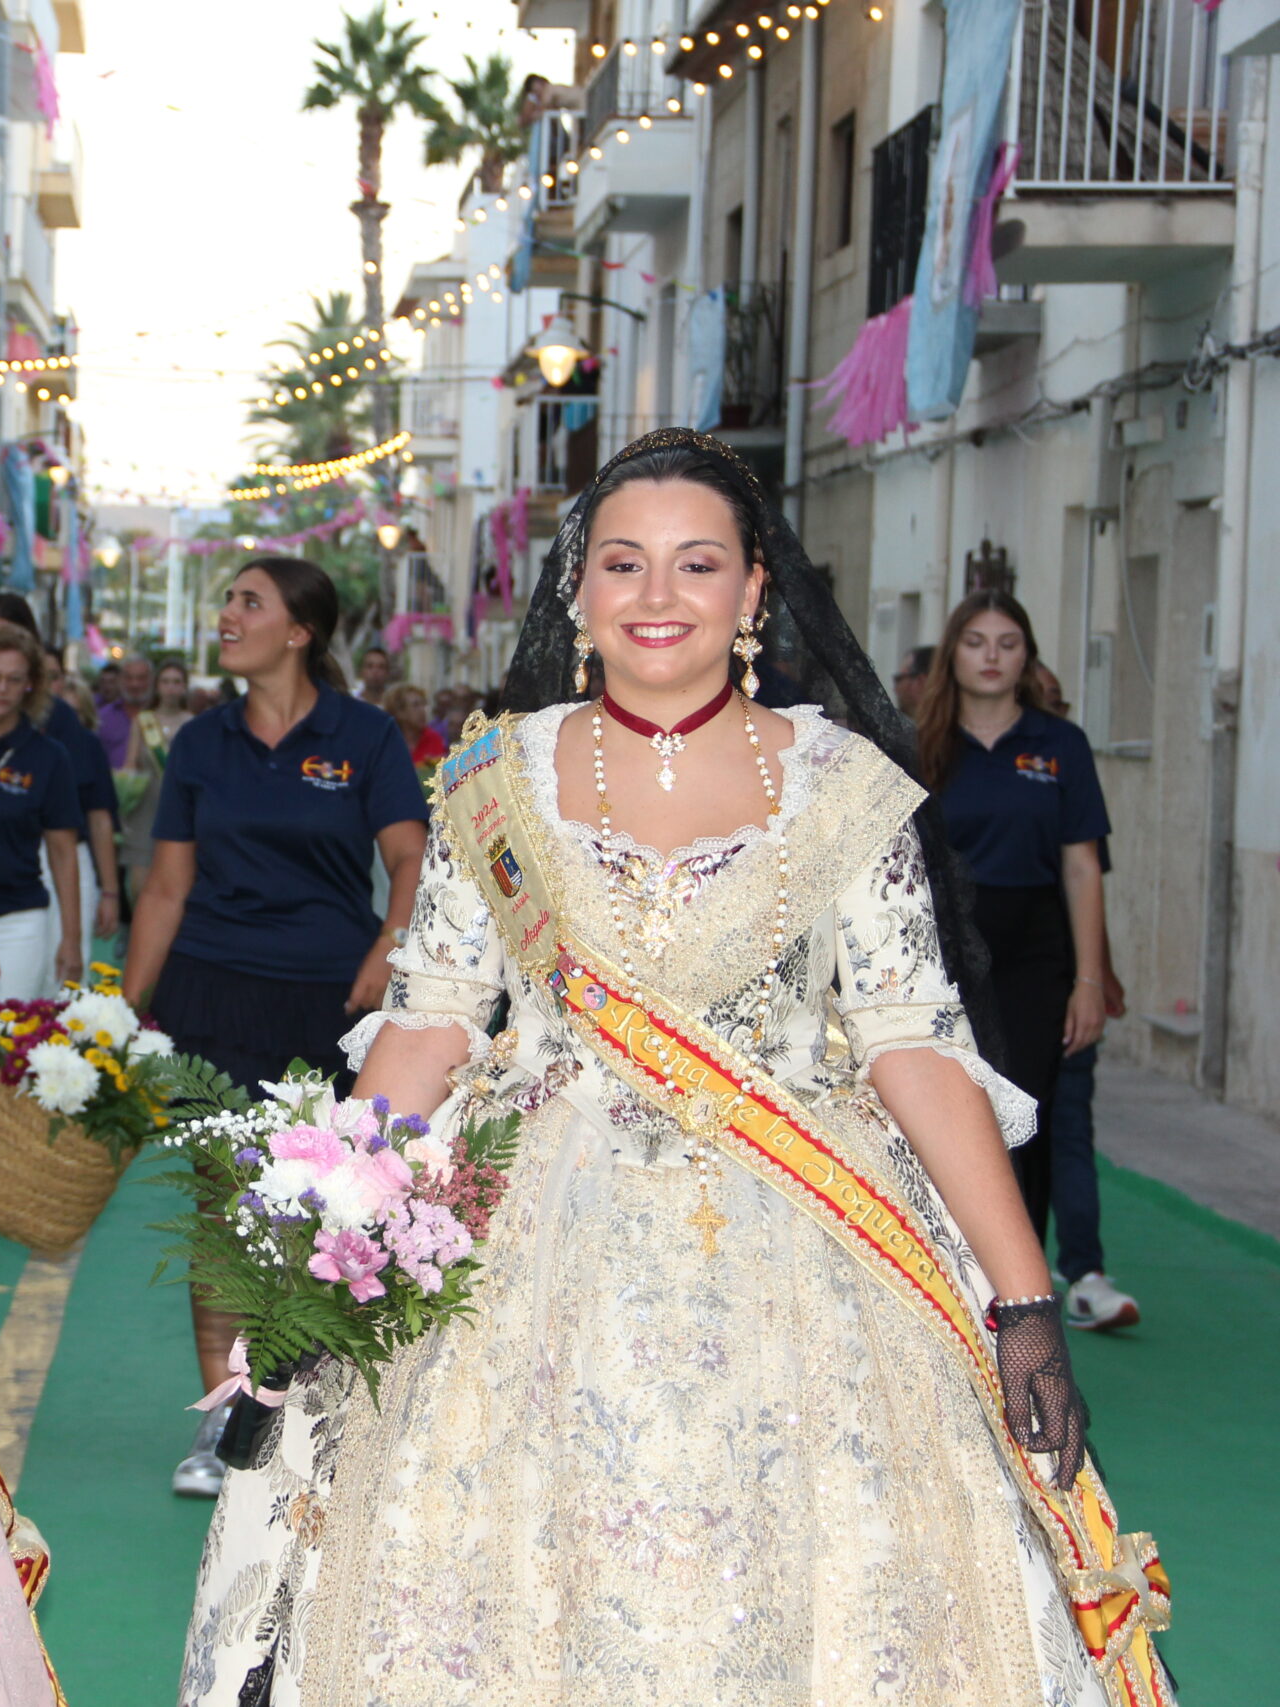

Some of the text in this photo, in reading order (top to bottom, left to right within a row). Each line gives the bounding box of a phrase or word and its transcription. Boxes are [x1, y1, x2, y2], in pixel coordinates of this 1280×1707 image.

[471, 797, 500, 829] 2024
[610, 1002, 936, 1282] Reina de la Foguera
